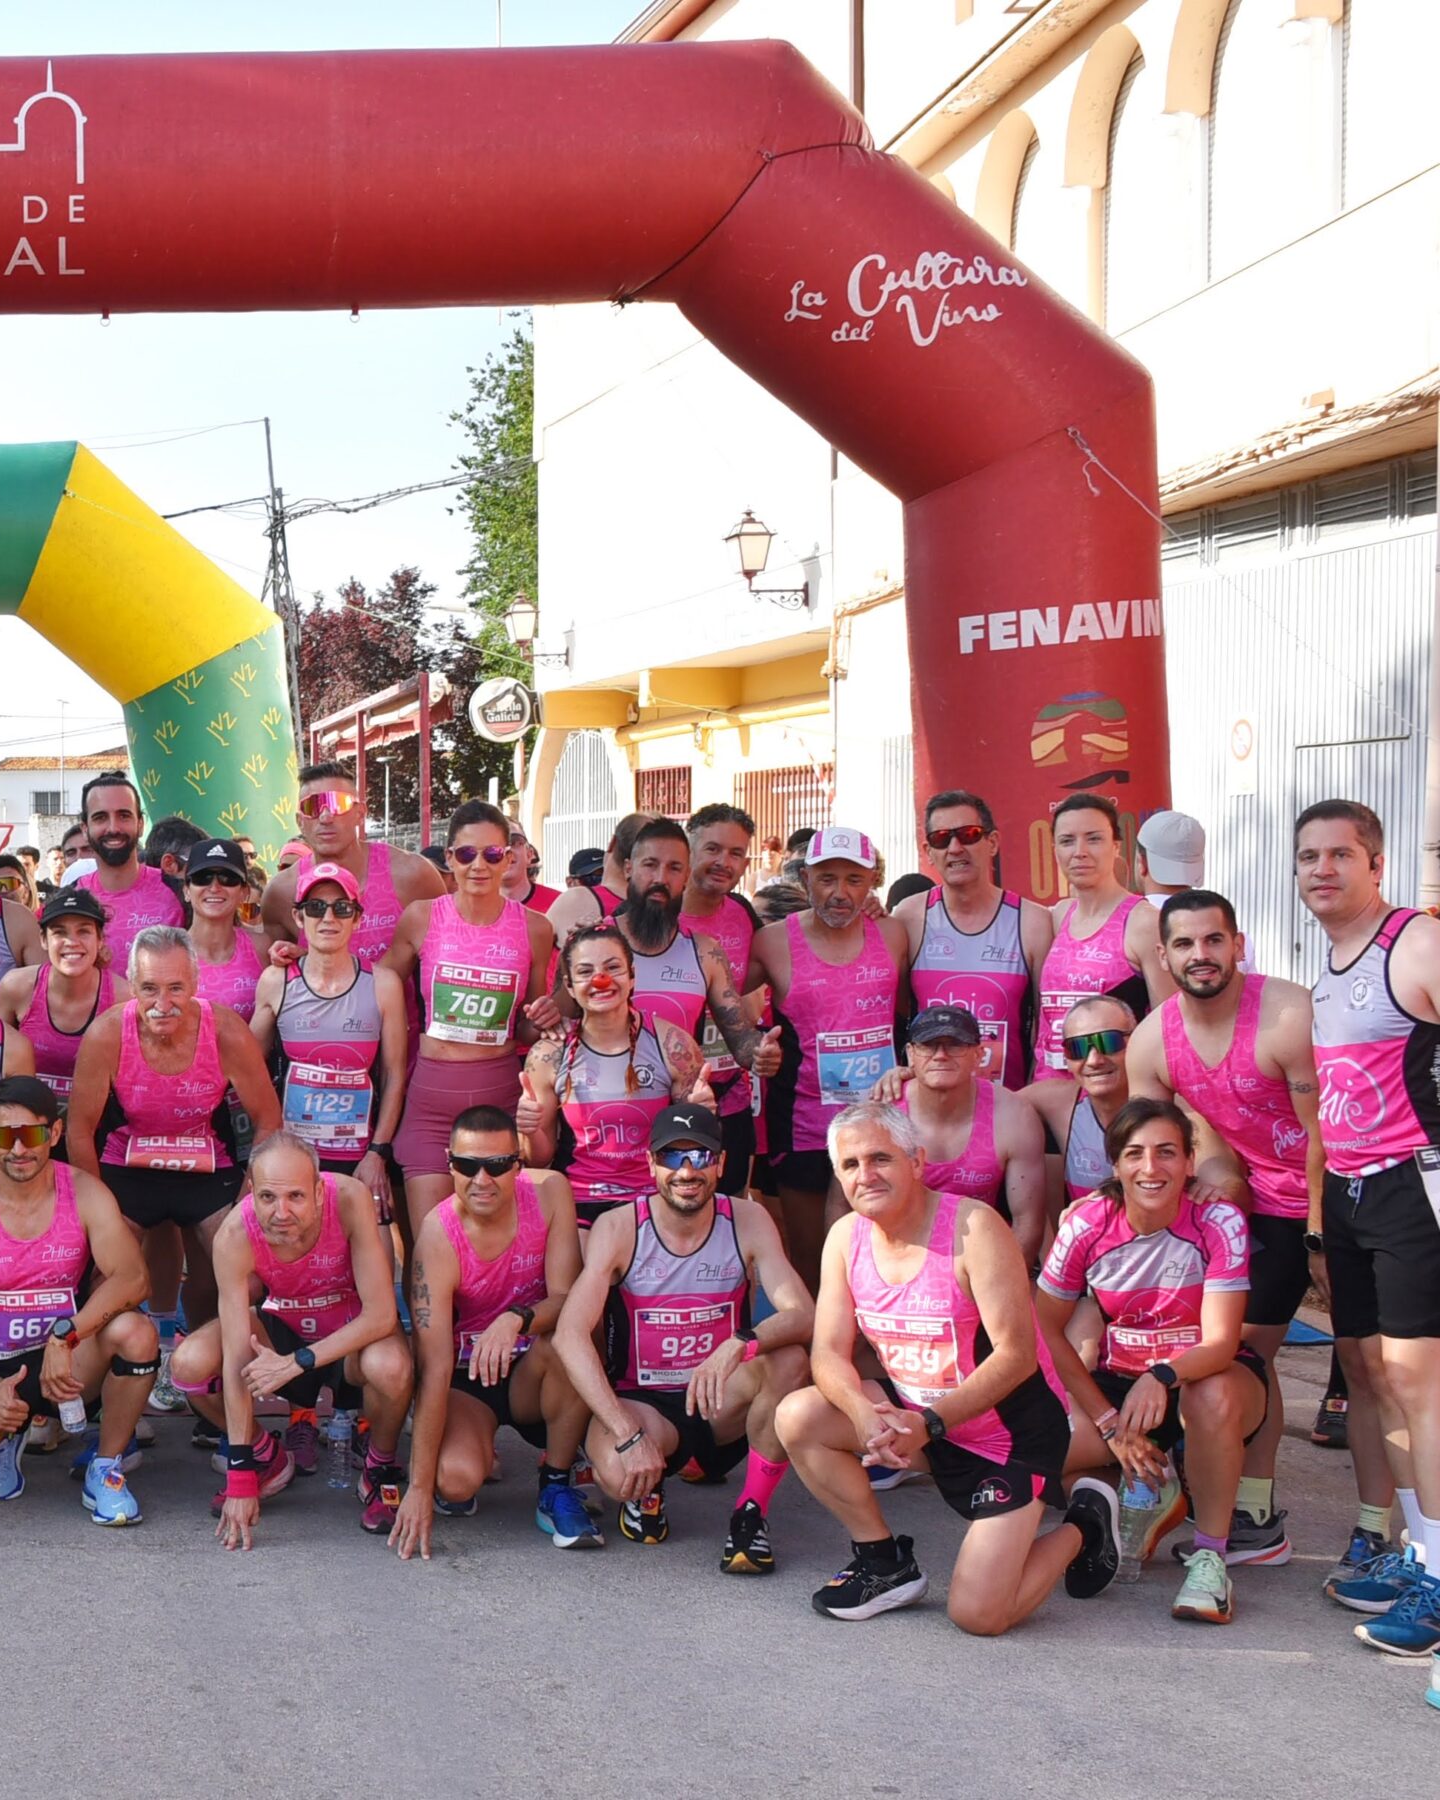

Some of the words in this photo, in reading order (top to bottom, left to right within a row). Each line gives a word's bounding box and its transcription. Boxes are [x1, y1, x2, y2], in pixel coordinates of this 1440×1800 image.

[22, 194, 86, 224] DE
[784, 279, 828, 323] La
[847, 251, 1028, 318] Cultura
[831, 319, 875, 343] del
[895, 291, 1004, 347] Vino
[958, 598, 1162, 655] FENAVIN
[358, 943, 388, 958] DESA
[440, 965, 512, 986] SOLISS
[448, 990, 498, 1018] 760
[824, 1029, 887, 1048] SOLISS
[296, 1067, 366, 1085] SOLISS
[840, 1054, 881, 1079] 726
[303, 1093, 355, 1113] 1129
[137, 1136, 206, 1148] SOLISS
[300, 1317, 317, 1334] 9
[645, 1307, 725, 1325] SOLISS
[863, 1315, 944, 1336] SOLISS
[8, 1316, 58, 1340] 667
[1114, 1330, 1199, 1346] SOLISS
[661, 1332, 714, 1359] 923
